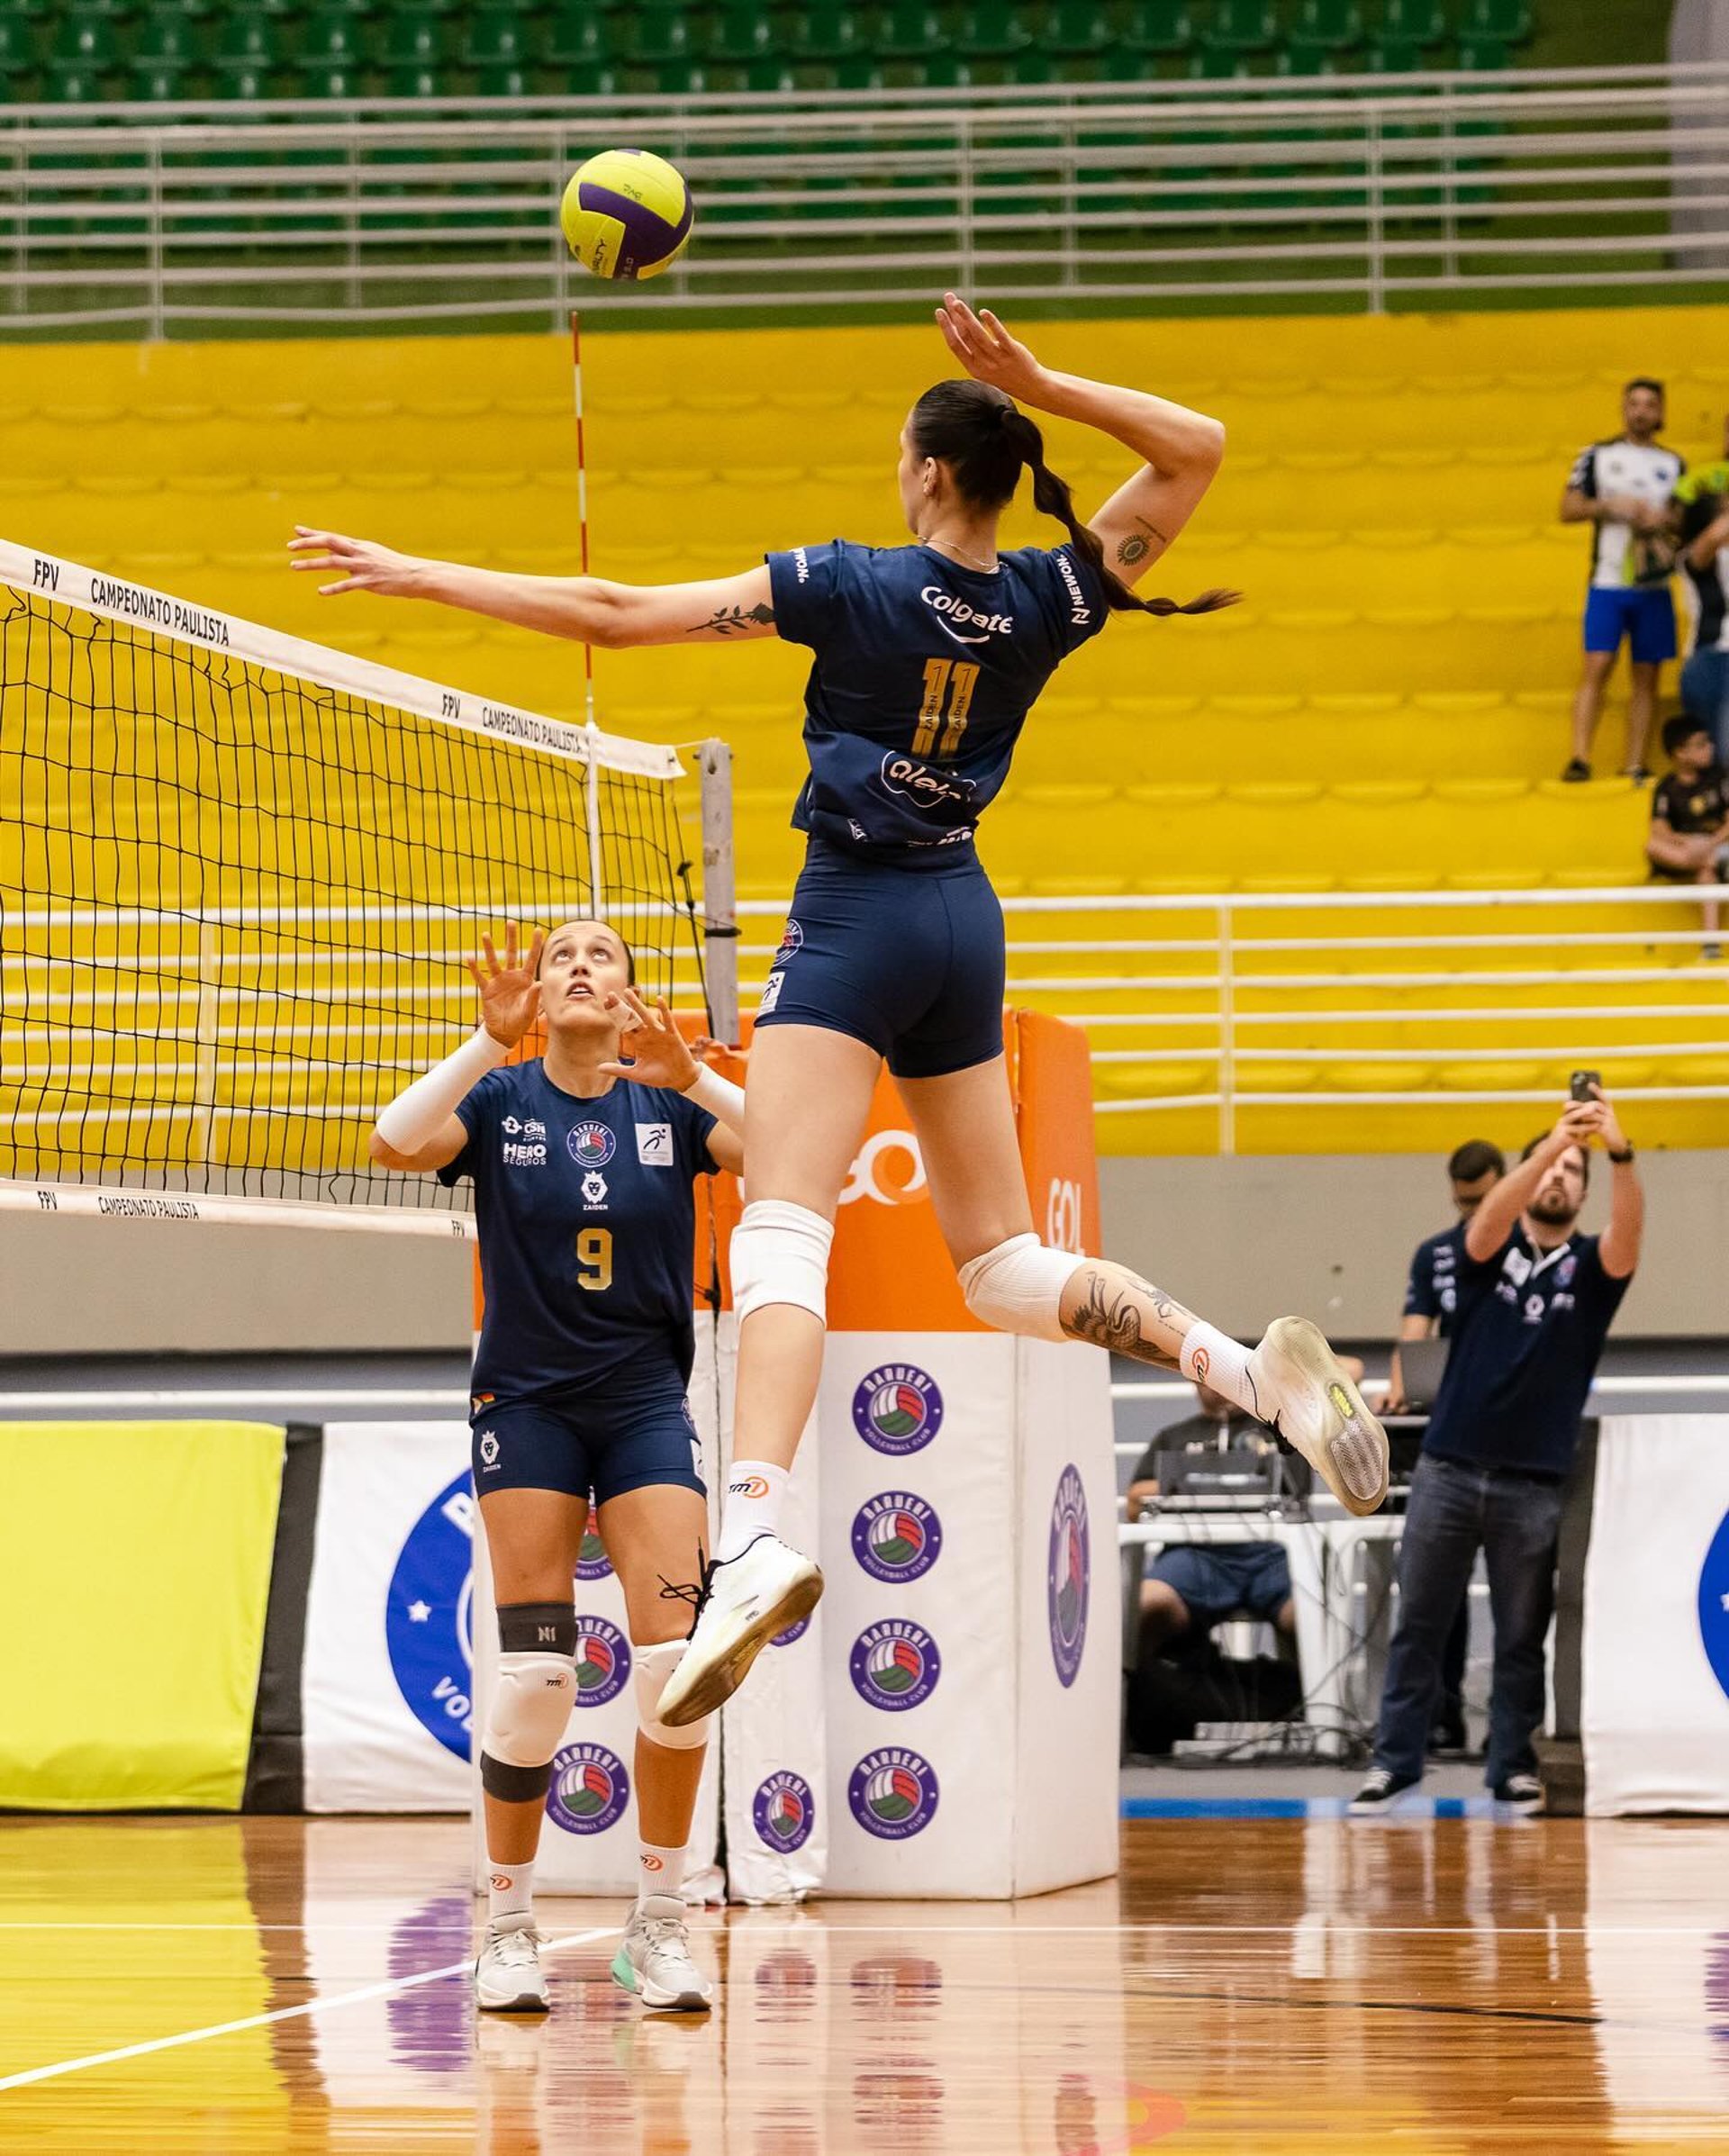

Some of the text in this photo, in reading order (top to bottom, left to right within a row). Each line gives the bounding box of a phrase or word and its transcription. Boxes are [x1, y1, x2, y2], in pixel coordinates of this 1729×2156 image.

[33, 559, 230, 646] FPV CAMPEONATO PAULISTA
[920, 585, 1013, 634] Colgate
[442, 693, 583, 754] FPV CAMPEONATO PAULISTA
[911, 658, 981, 757] 11
[503, 1143, 548, 1159] HERO
[503, 1155, 548, 1166] SEGUROS
[37, 1191, 58, 1211] FPV
[98, 1196, 157, 1218] CAMPEONATO
[158, 1200, 200, 1220] PAULISTA
[577, 1227, 613, 1291] 9
